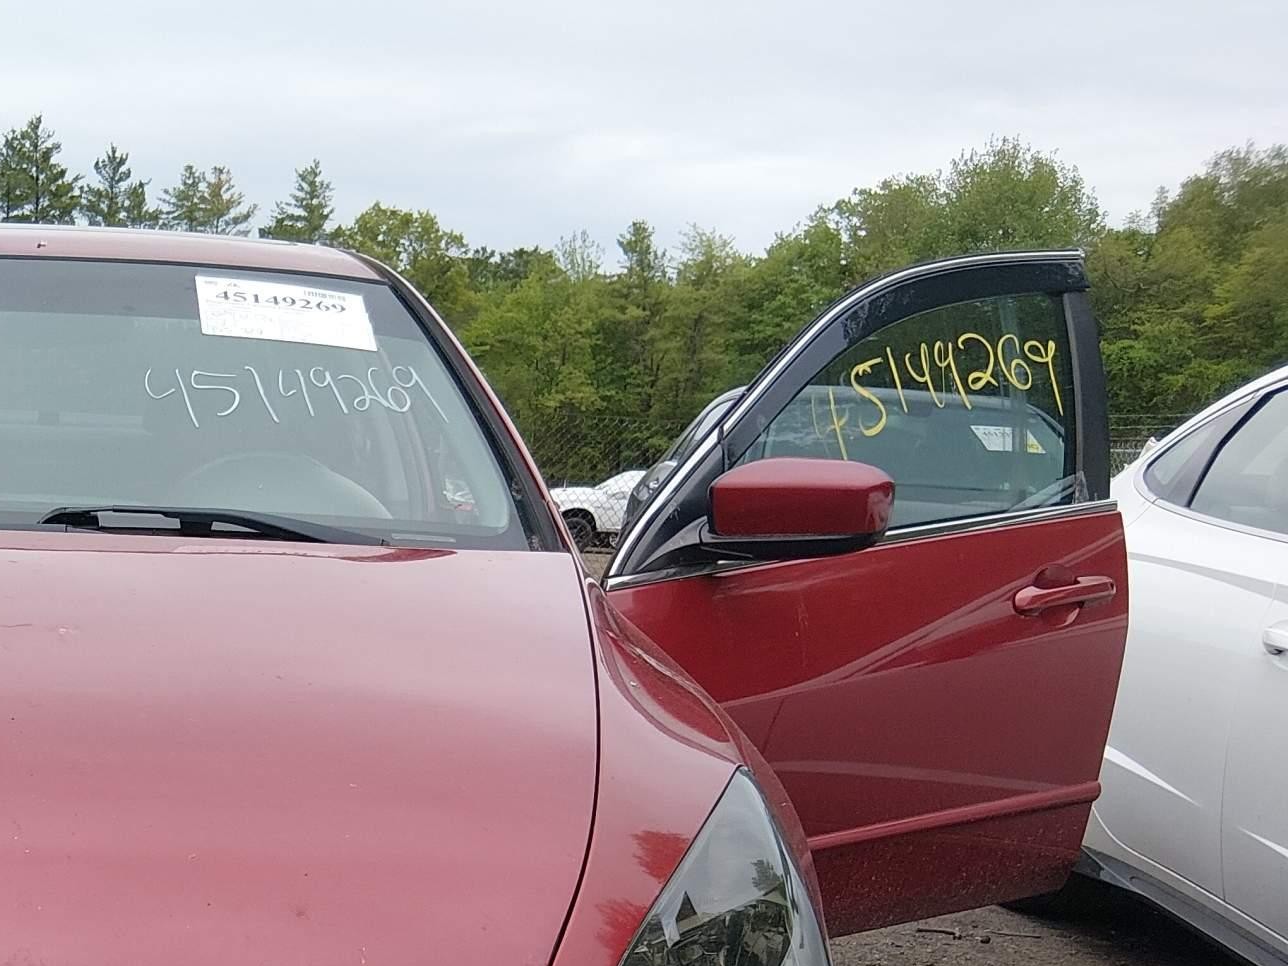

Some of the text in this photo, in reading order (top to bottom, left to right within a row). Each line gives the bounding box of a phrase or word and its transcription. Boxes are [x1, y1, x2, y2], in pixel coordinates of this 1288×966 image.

[215, 290, 346, 312] 45149269
[144, 366, 450, 429] 45149269
[810, 332, 1065, 460] 45149269
